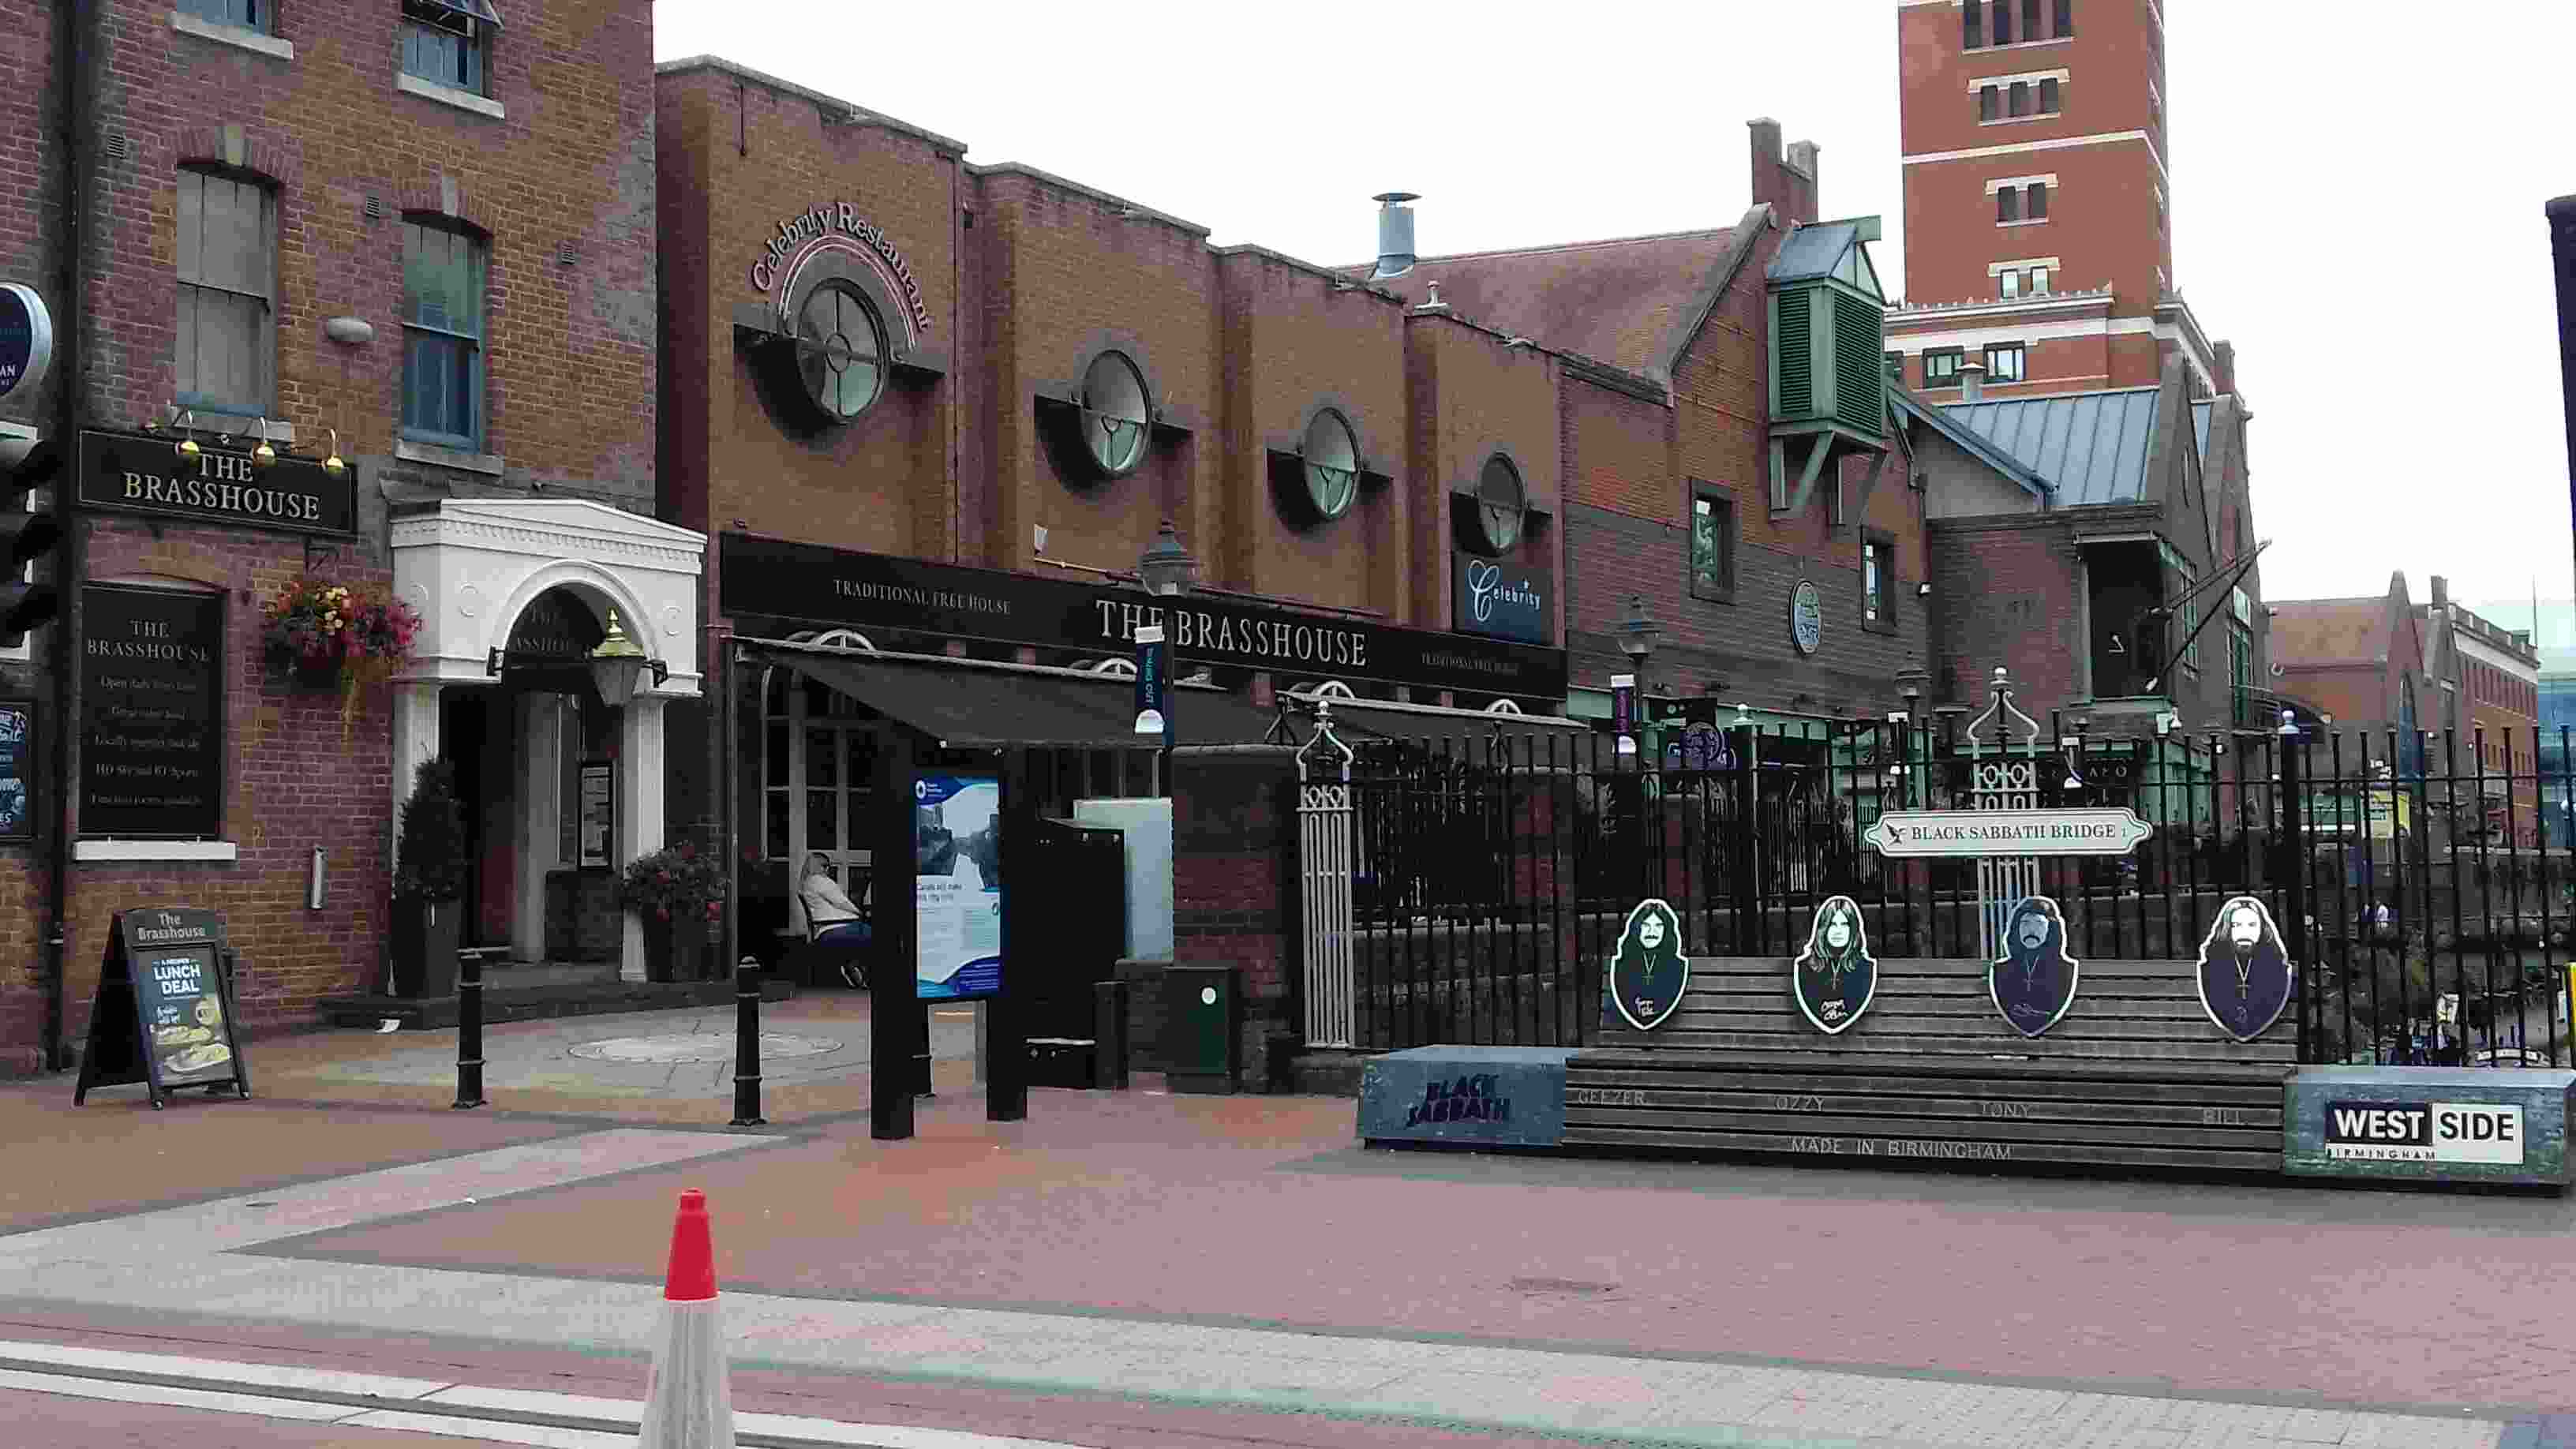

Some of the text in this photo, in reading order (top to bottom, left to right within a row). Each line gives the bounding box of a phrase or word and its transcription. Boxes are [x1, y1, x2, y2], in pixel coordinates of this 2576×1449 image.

[752, 200, 930, 332] Celebrity Restaurant
[198, 454, 253, 482] THE
[124, 472, 320, 520] BRASSHOUSE
[833, 578, 1011, 615] TRADITIONAL FREE HOUSE
[1467, 560, 1541, 622] Celebrity
[129, 620, 170, 638] THE
[1095, 599, 1165, 640] THE
[1175, 609, 1367, 667] BRASSHOUSE
[87, 638, 208, 662] BRASSHOUSE
[1911, 824, 2116, 841] BLACK SABBATH BRIDGE
[158, 913, 182, 927] The
[137, 927, 205, 942] Brasshouse
[153, 964, 201, 980] LUNCH
[161, 978, 200, 994] DEAL
[1774, 1095, 1825, 1112] OZZY
[1981, 1103, 2033, 1118] TONY
[2202, 1108, 2246, 1125] BILL
[2334, 1109, 2514, 1141] WEST SIDE
[1788, 1137, 2013, 1160] MADE IN BIRMINGHAM
